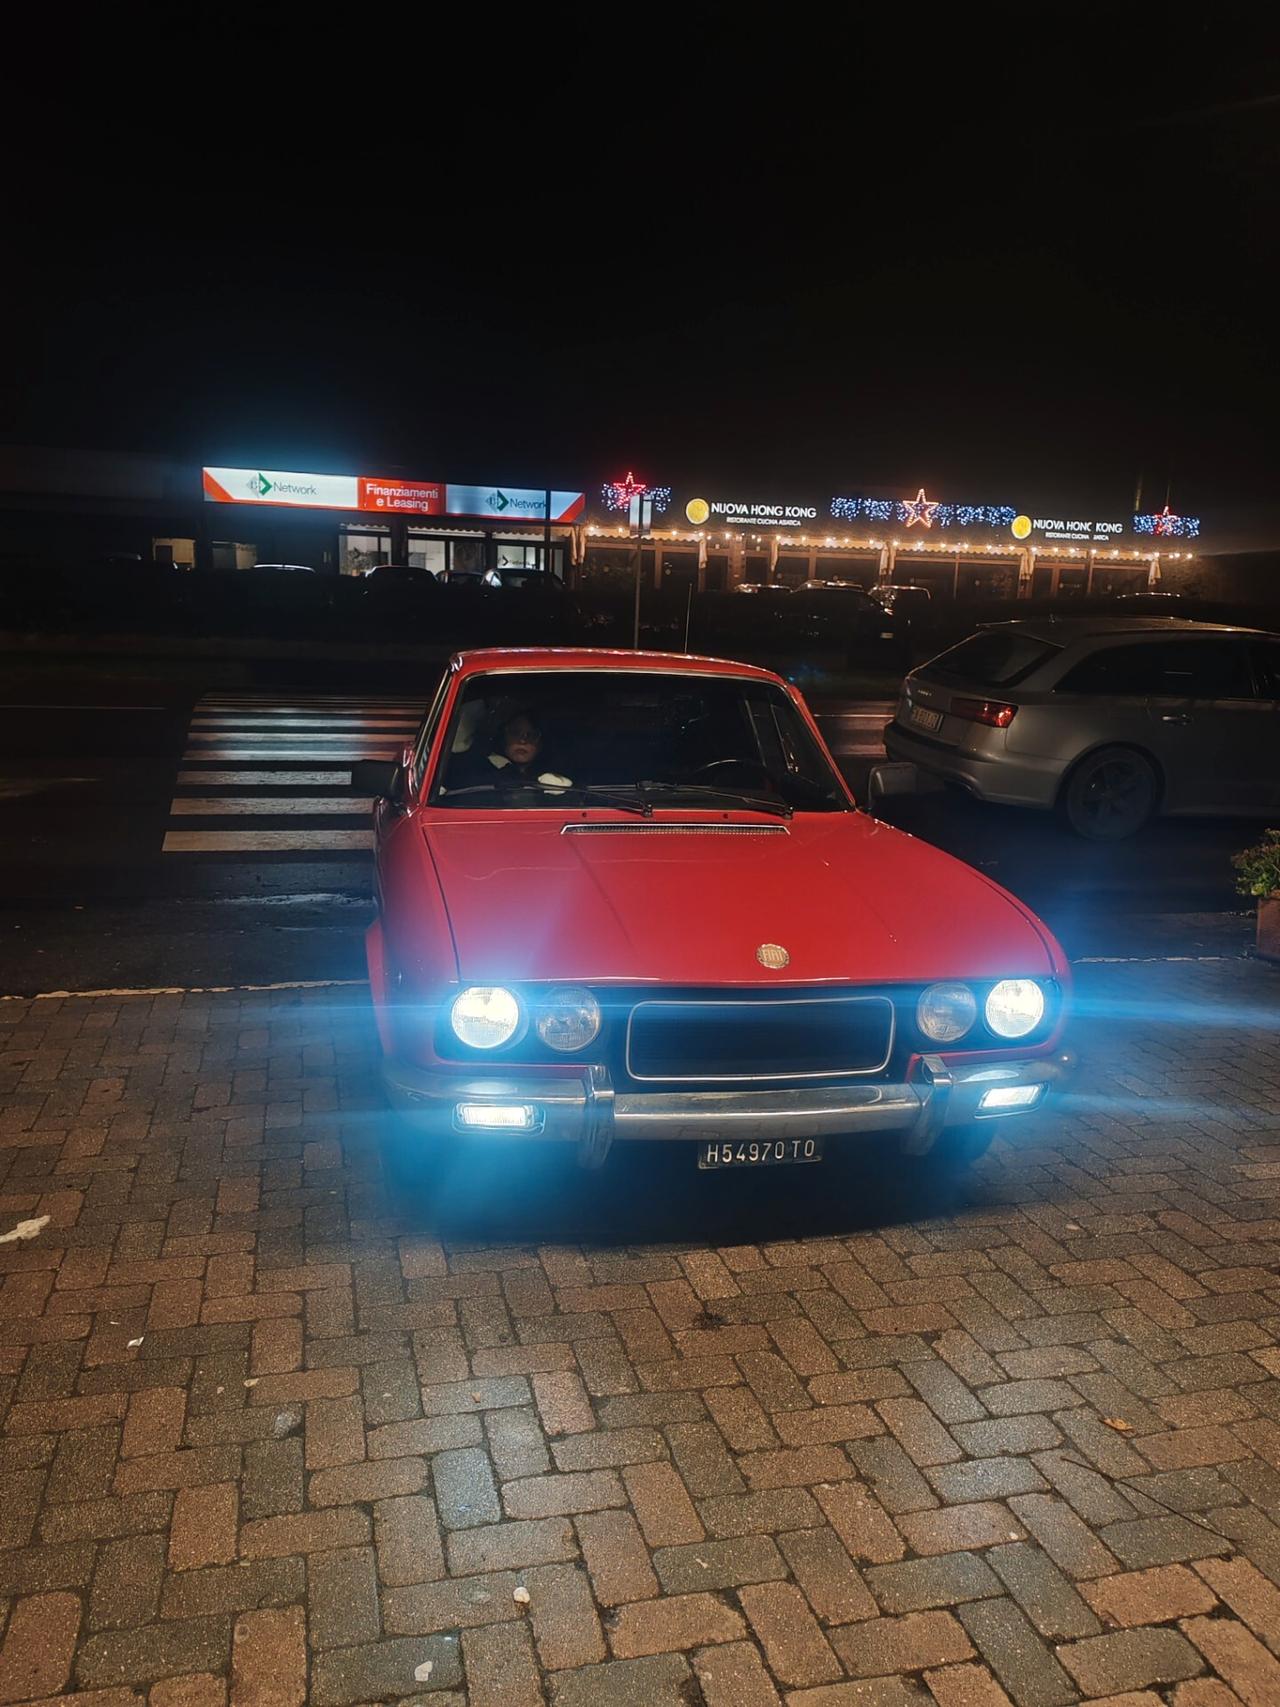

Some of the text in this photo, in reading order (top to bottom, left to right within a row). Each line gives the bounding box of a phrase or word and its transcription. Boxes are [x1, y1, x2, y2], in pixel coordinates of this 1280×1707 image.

[273, 481, 317, 495] Network
[366, 483, 438, 498] Finanziamenti
[376, 497, 428, 511] e Leasing
[711, 503, 816, 518] NUOVA HONG KONG
[1033, 519, 1065, 530] NUOVA
[1096, 523, 1123, 533] KONG
[707, 1139, 815, 1164] H54970 TO
